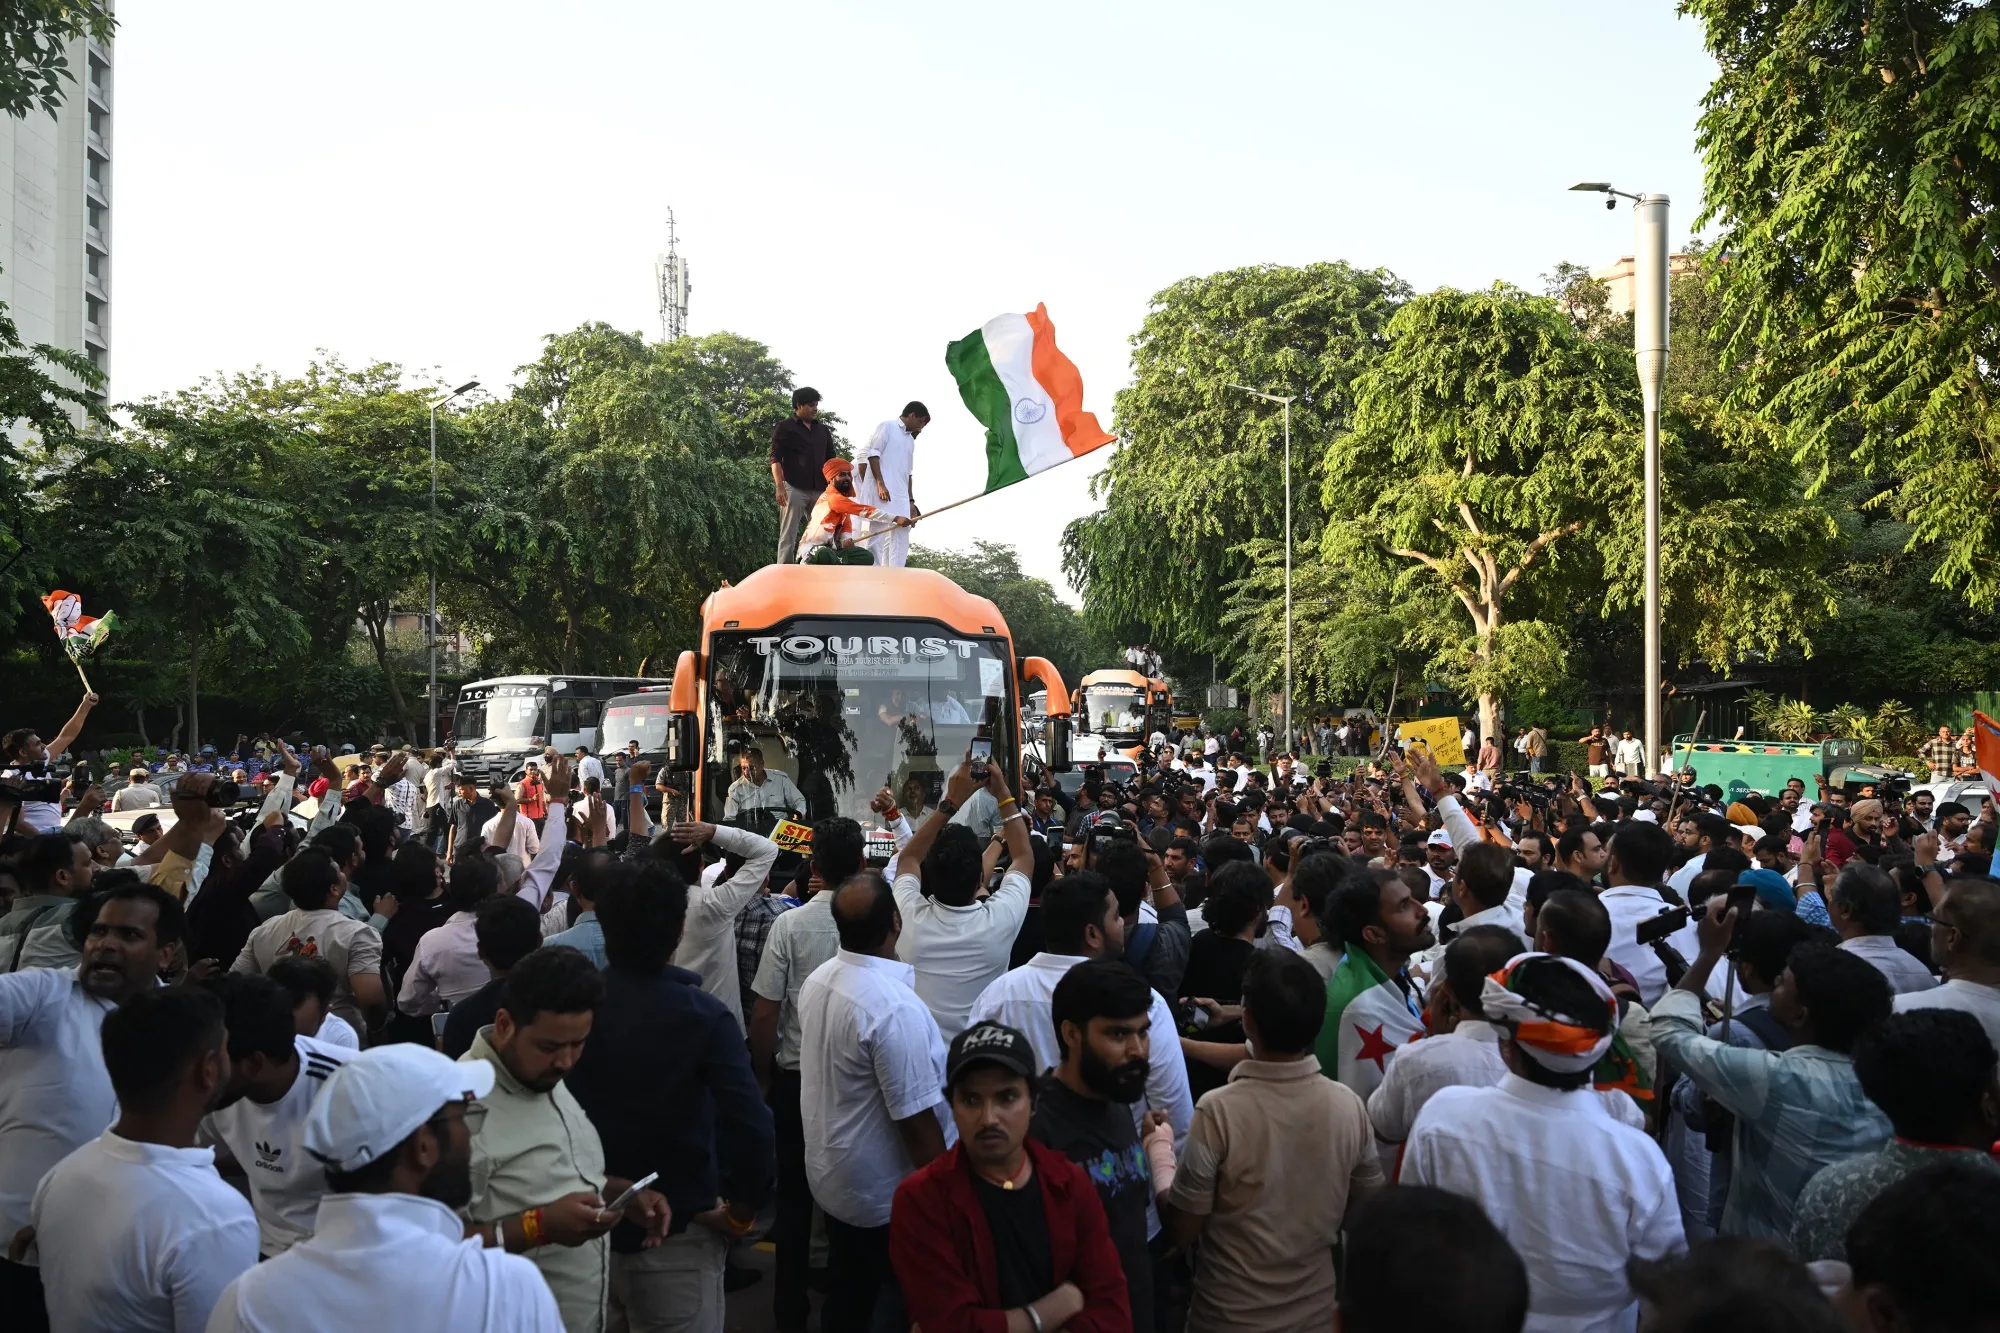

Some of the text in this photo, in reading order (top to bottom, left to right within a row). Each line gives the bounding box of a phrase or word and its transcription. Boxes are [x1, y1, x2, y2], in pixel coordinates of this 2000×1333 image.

[747, 636, 979, 658] TOURIST
[824, 657, 835, 665] ALL
[855, 657, 880, 665] TOURIST
[881, 657, 905, 665] PERMIT
[466, 687, 540, 700] TOURIST
[776, 832, 799, 844] VOTE
[783, 824, 815, 841] STO
[870, 837, 894, 850] VOTE
[962, 1026, 1014, 1048] KTM
[961, 1041, 1012, 1054] RACING
[255, 1160, 284, 1172] adidas
